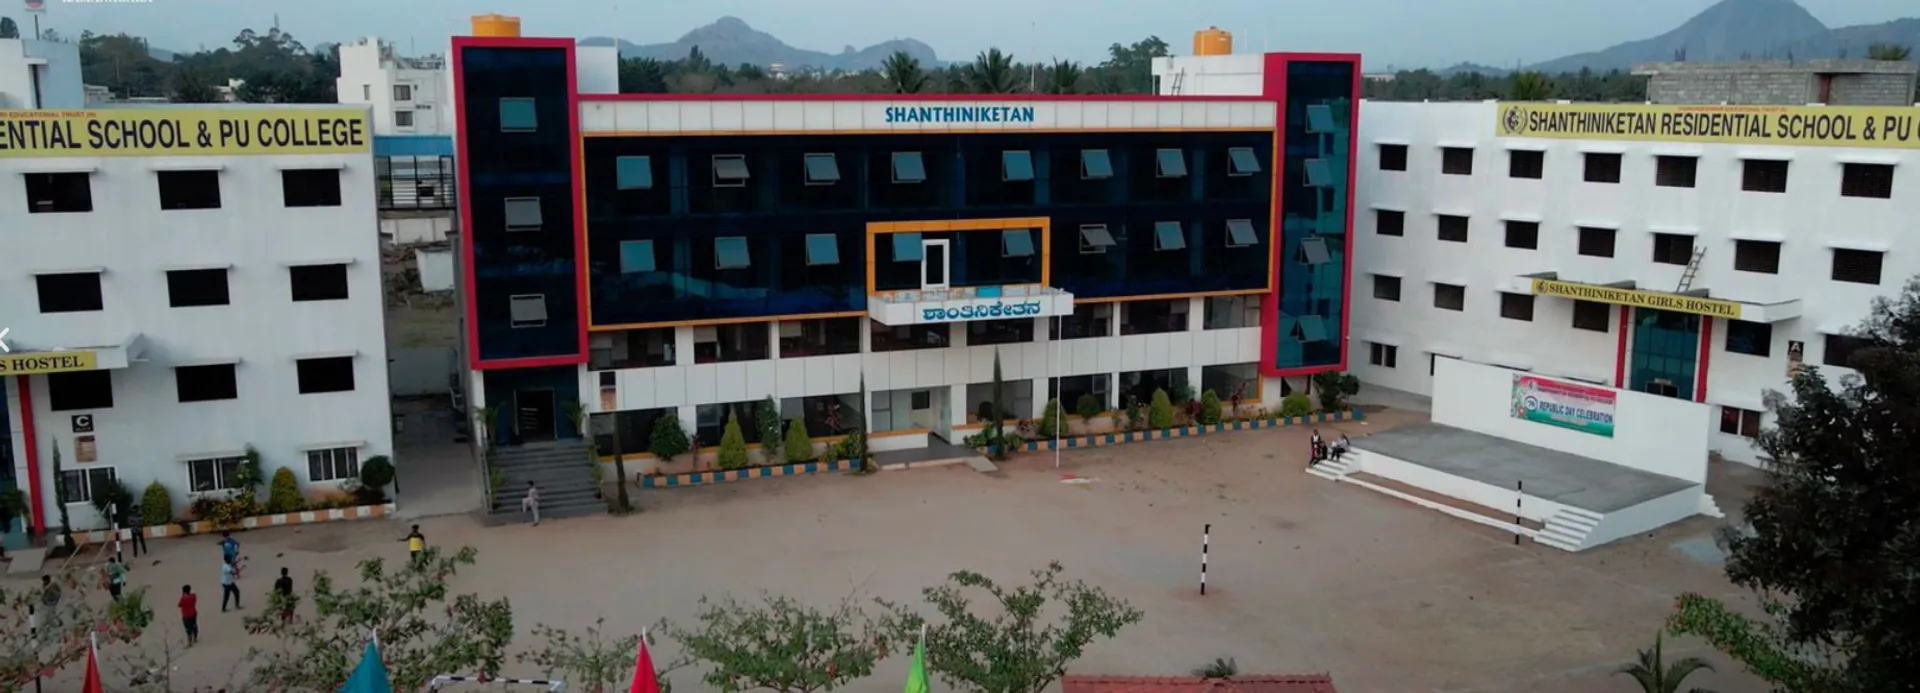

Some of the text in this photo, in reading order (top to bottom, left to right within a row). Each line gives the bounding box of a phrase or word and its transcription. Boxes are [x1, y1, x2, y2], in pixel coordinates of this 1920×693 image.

[885, 106, 1035, 123] SHANTHINIKETAN
[87, 119, 191, 149] SCHOOL
[196, 119, 213, 148] &
[219, 119, 250, 148] PU
[257, 118, 364, 147] COLLEGE
[1529, 110, 1657, 135] SHANTHINIKETAN
[1660, 112, 1771, 138] RESIDENTIAL
[1777, 114, 1857, 140] SCHOOL
[1863, 115, 1877, 141] &
[1883, 115, 1912, 142] PU
[1549, 281, 1736, 316] SHANTHINIKETAN GIRLS HOSTEL
[922, 300, 1041, 321] ಶಾಂತಿನಿಕೇತನ
[12, 355, 84, 372] HOSTEL
[1539, 400, 1565, 415] REPUBLIC
[1565, 404, 1576, 417] DAY
[76, 416, 90, 427] C
